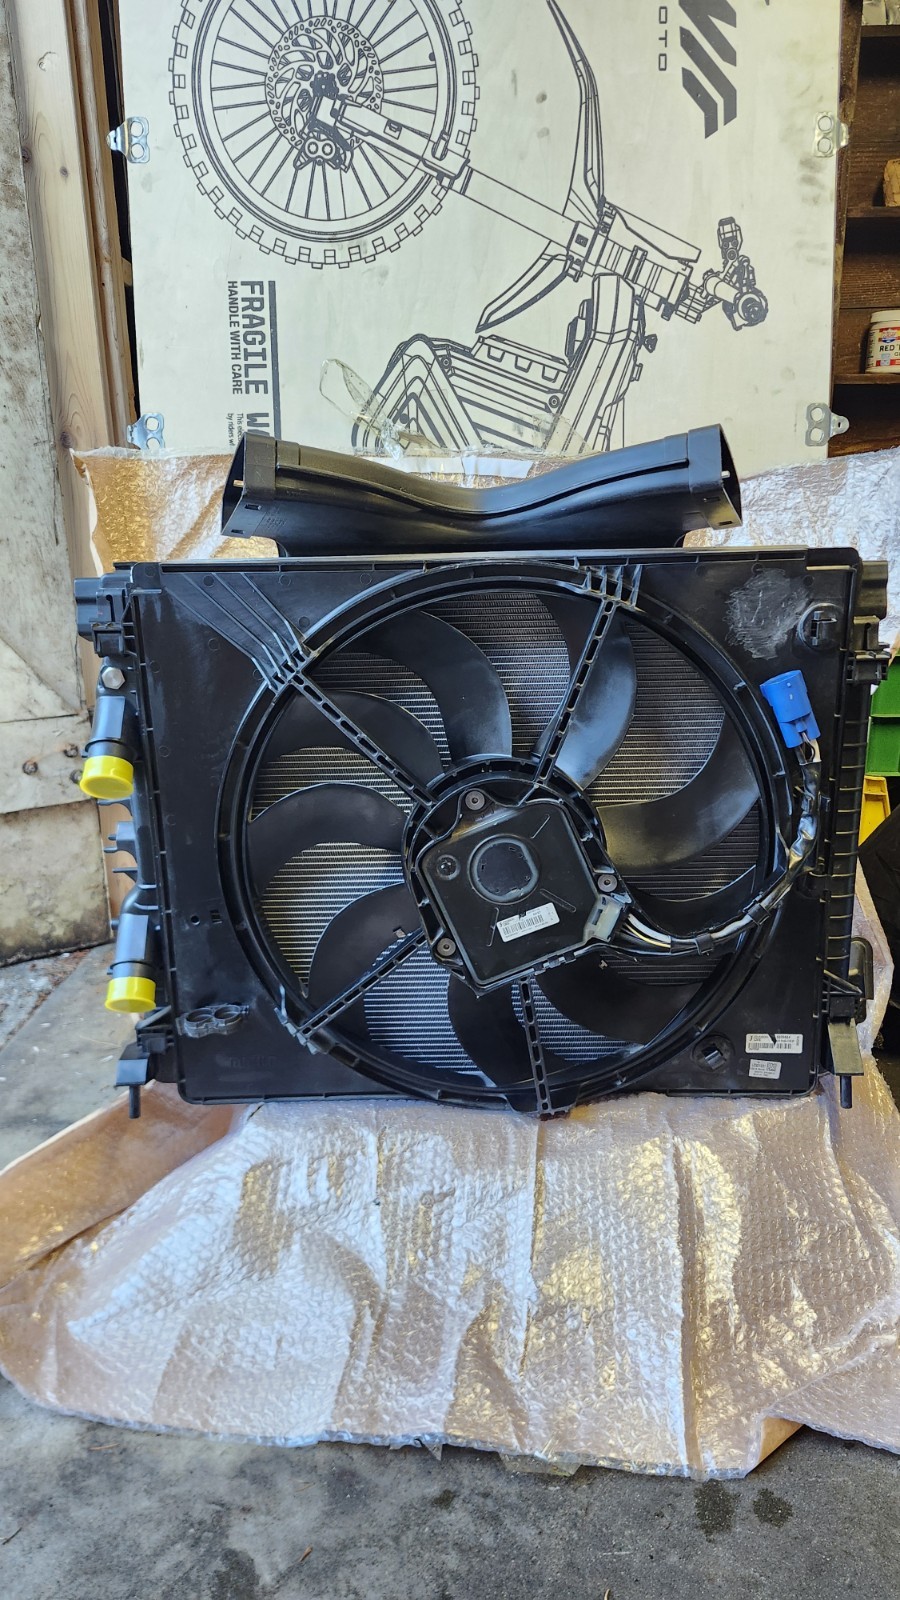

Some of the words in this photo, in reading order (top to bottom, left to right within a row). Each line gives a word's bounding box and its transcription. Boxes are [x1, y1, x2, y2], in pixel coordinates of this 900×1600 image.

[228, 281, 240, 328] HANDLE
[230, 330, 242, 360] WITH
[240, 280, 269, 395] FRAGILE
[232, 363, 243, 395] CARE
[226, 413, 234, 421] by
